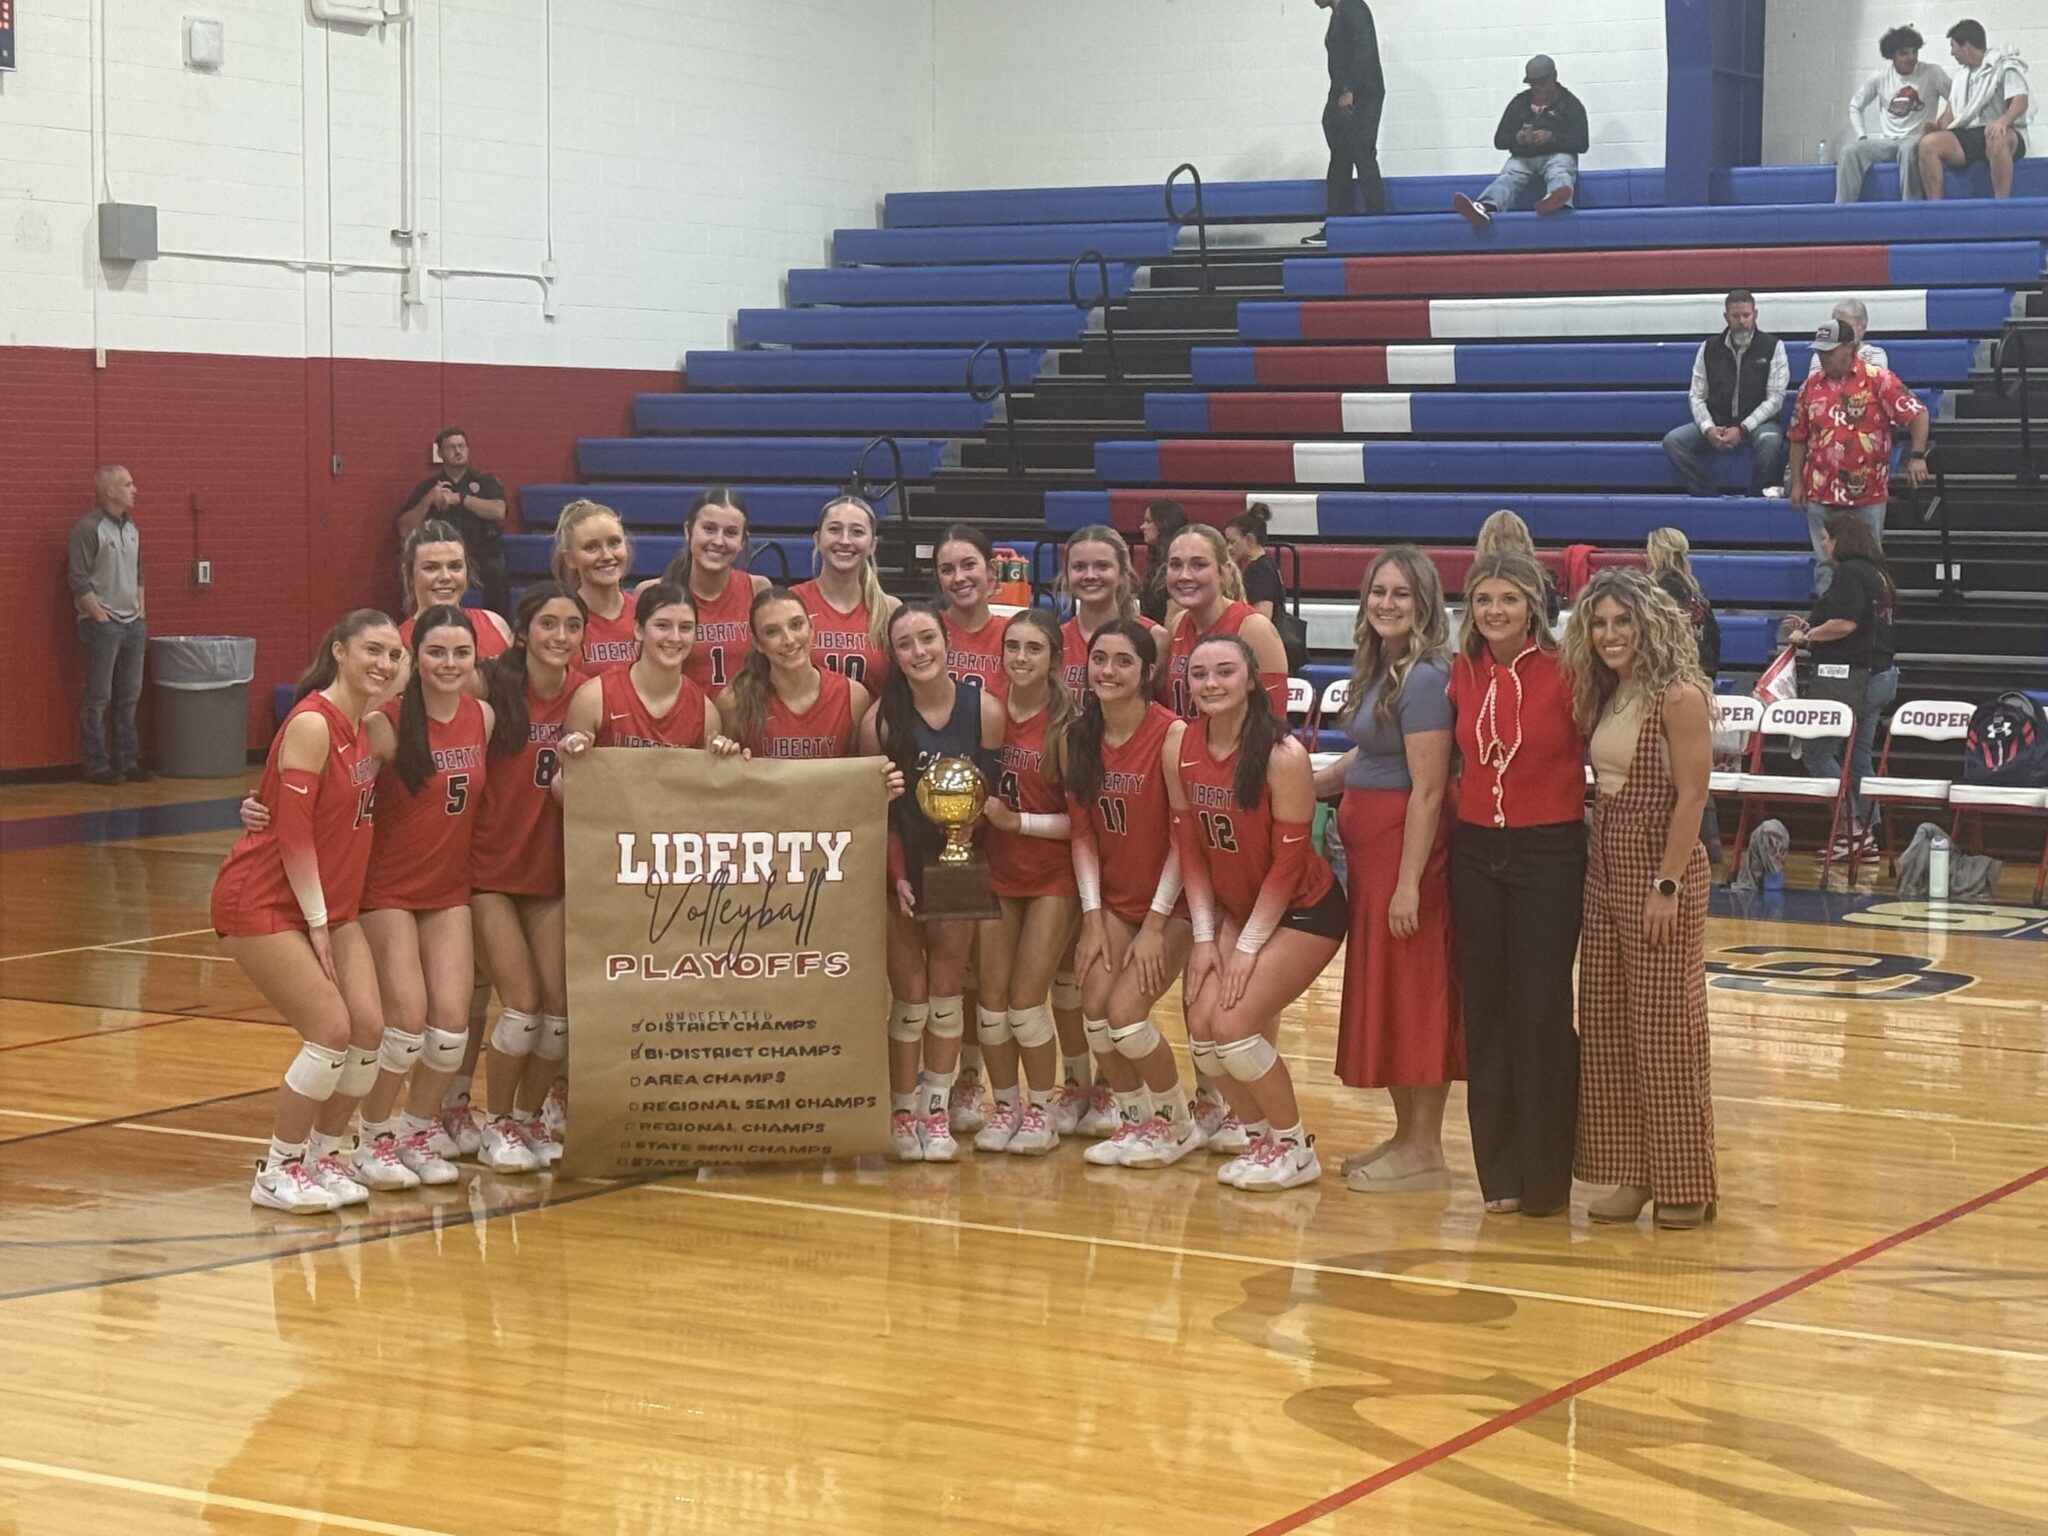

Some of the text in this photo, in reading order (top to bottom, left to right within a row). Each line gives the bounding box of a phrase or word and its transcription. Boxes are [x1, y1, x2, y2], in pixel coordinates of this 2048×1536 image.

[695, 622, 749, 643] BERTY
[582, 641, 638, 664] LIBERT
[946, 651, 1001, 673] BERTY
[710, 646, 727, 686] 1
[1721, 707, 1754, 721] PER
[1772, 708, 1842, 726] COOPER
[1900, 710, 1971, 728] COOPER
[762, 735, 837, 758] LIBERTY
[434, 745, 482, 773] BERTY
[533, 747, 558, 789] 8
[1002, 745, 1047, 773] ERTY
[445, 773, 470, 815] 5
[999, 770, 1022, 811] 4
[1102, 771, 1145, 796] ERTY
[1098, 796, 1128, 836] 11
[1199, 810, 1239, 853] 12
[616, 830, 852, 886] LIBERTY
[644, 866, 826, 971] Volleyball
[606, 951, 851, 981] PLAYOFFS
[644, 1019, 817, 1033] DISTRICT CHAMPS
[665, 1010, 774, 1022] UNDEFEATED
[644, 1044, 842, 1060] BI-DISTRICT CHAMPS
[643, 1070, 787, 1087] AREA CHAMPS
[641, 1096, 877, 1112] REGIONAL SEMI CHAMPS
[639, 1122, 826, 1133] REGIONAL CHAMPS
[635, 1140, 833, 1155] STATE SEMI CHAMPS
[631, 1156, 688, 1167] STATE
